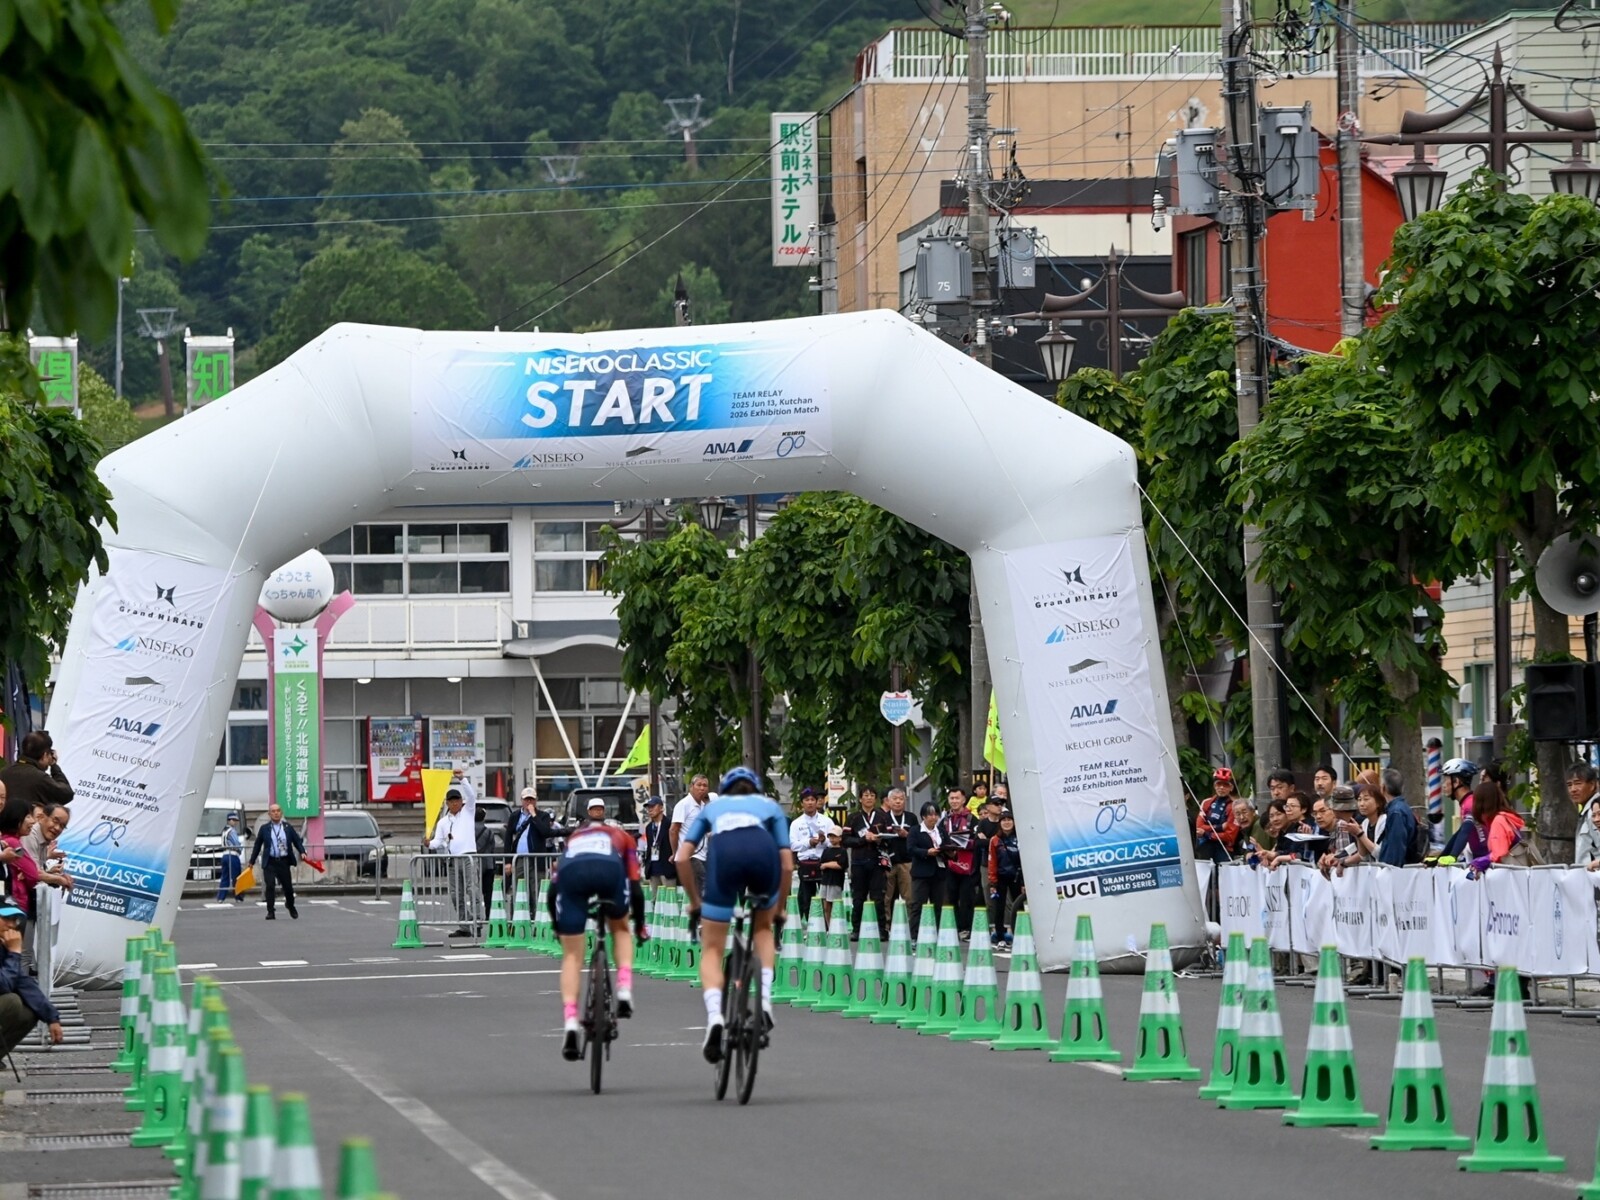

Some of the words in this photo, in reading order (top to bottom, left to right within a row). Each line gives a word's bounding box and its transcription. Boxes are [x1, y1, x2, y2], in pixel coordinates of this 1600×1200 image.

[802, 122, 813, 186] ビジネス
[780, 123, 801, 244] 駅前ホテル
[1022, 267, 1032, 277] 30
[938, 281, 951, 292] 75
[192, 351, 230, 401] 知
[520, 374, 713, 429] START
[732, 391, 756, 400] TEAM
[757, 389, 783, 399] RELAY
[730, 411, 749, 419] 2026
[750, 407, 792, 418] Exhibition
[793, 405, 820, 415] Match
[731, 402, 750, 410] 2025
[751, 400, 766, 408] Jun
[767, 399, 778, 408] 13,
[779, 397, 813, 406] Kutchan
[702, 442, 736, 455] ANA
[532, 452, 584, 463] NISEKO
[276, 571, 312, 583] ようこそ
[264, 588, 322, 600] くっちゃん町へ
[1033, 589, 1075, 601] NISEKO
[1081, 584, 1117, 594] TOKYU
[1035, 597, 1071, 609] Grand
[1075, 591, 1118, 603] HIRAFU
[119, 605, 154, 619] Grand
[157, 613, 204, 629] HIRAFU
[1065, 617, 1120, 636] NISEKO
[136, 635, 194, 659] NISEKO
[1048, 677, 1083, 689] NISEKO
[1085, 671, 1129, 684] CLIFFSIDE
[101, 684, 135, 697] NISEKO
[1070, 703, 1103, 720] ANA
[108, 716, 142, 735] ANA
[1070, 719, 1098, 728] Inspiration
[1065, 738, 1102, 751] IKEUCHI
[1103, 734, 1133, 746] GROUP
[92, 748, 128, 764] IKEUCHI
[130, 756, 161, 770] GROUP
[1079, 762, 1102, 772] TEAM
[1104, 759, 1129, 768] RELAY
[97, 773, 121, 784] TEAM
[1064, 776, 1082, 784] 2025
[1083, 773, 1098, 781] Jun
[1099, 771, 1109, 779] 13,
[1111, 767, 1142, 777] Kutchan
[78, 779, 96, 789] 2025
[97, 783, 111, 792] Jun
[111, 786, 122, 796] 13,
[125, 789, 157, 803] Kutchan
[1062, 785, 1081, 794] 2026
[1082, 779, 1123, 791] Exhibition
[1125, 775, 1148, 785] Match
[74, 788, 91, 798] 2026
[91, 792, 133, 808] Exhibition
[135, 801, 160, 813] Match
[1099, 798, 1127, 807] KEIRIN
[100, 814, 130, 826] KEIRIN
[1102, 876, 1125, 886] GRAN
[1126, 872, 1152, 882] FONDO
[1103, 883, 1131, 893] WORLD
[1132, 879, 1157, 889] SERIES
[96, 892, 124, 905] FONDO
[1063, 881, 1097, 899] UCI
[70, 895, 99, 907] WORLD
[100, 902, 126, 914] SERIES
